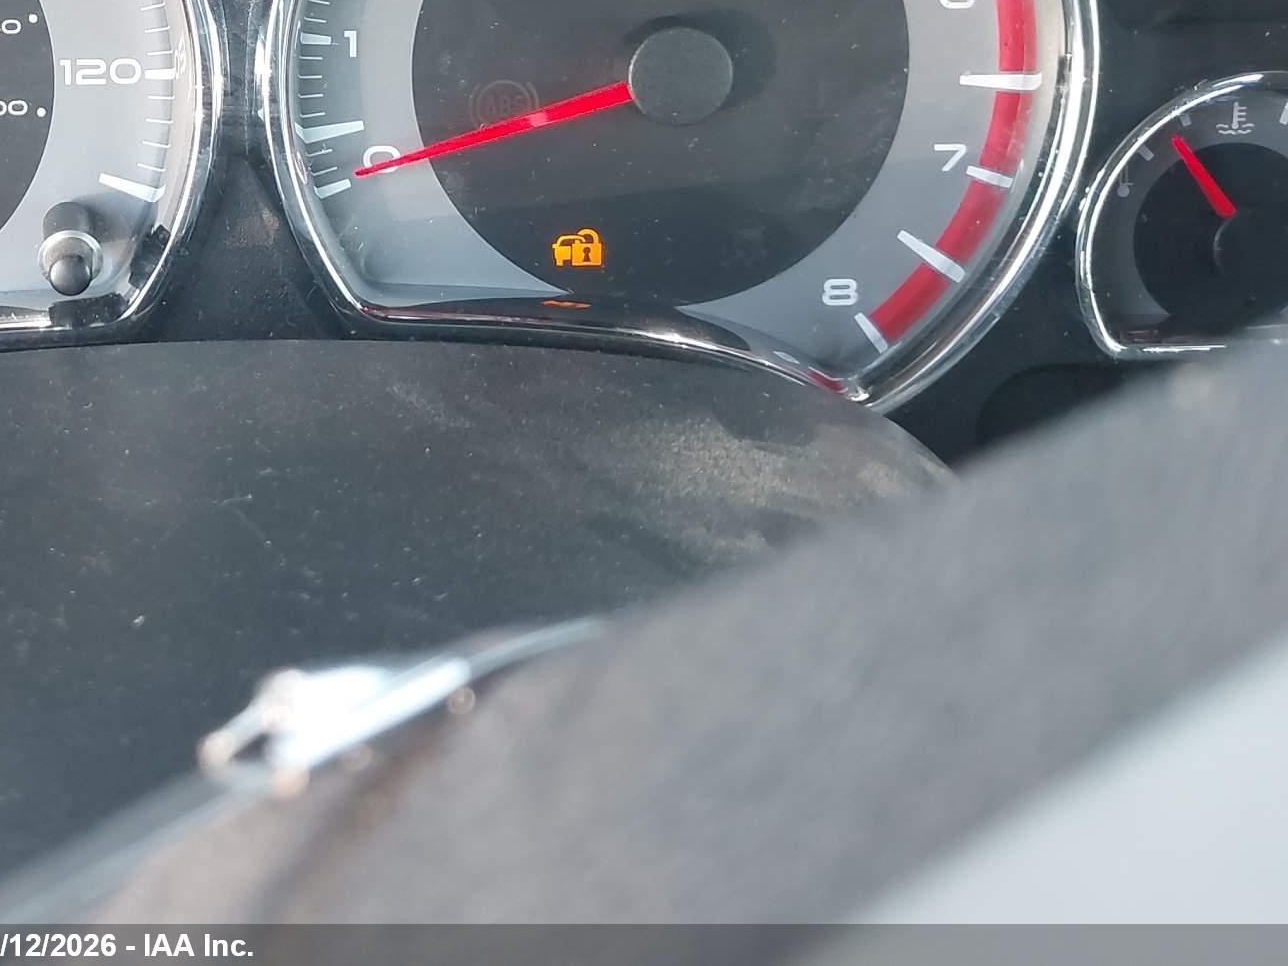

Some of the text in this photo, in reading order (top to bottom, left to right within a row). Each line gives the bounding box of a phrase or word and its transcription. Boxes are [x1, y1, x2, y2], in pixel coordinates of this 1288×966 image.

[344, 30, 358, 57] 1
[60, 59, 141, 85] 120
[935, 145, 966, 172] 7
[822, 279, 856, 305] 8
